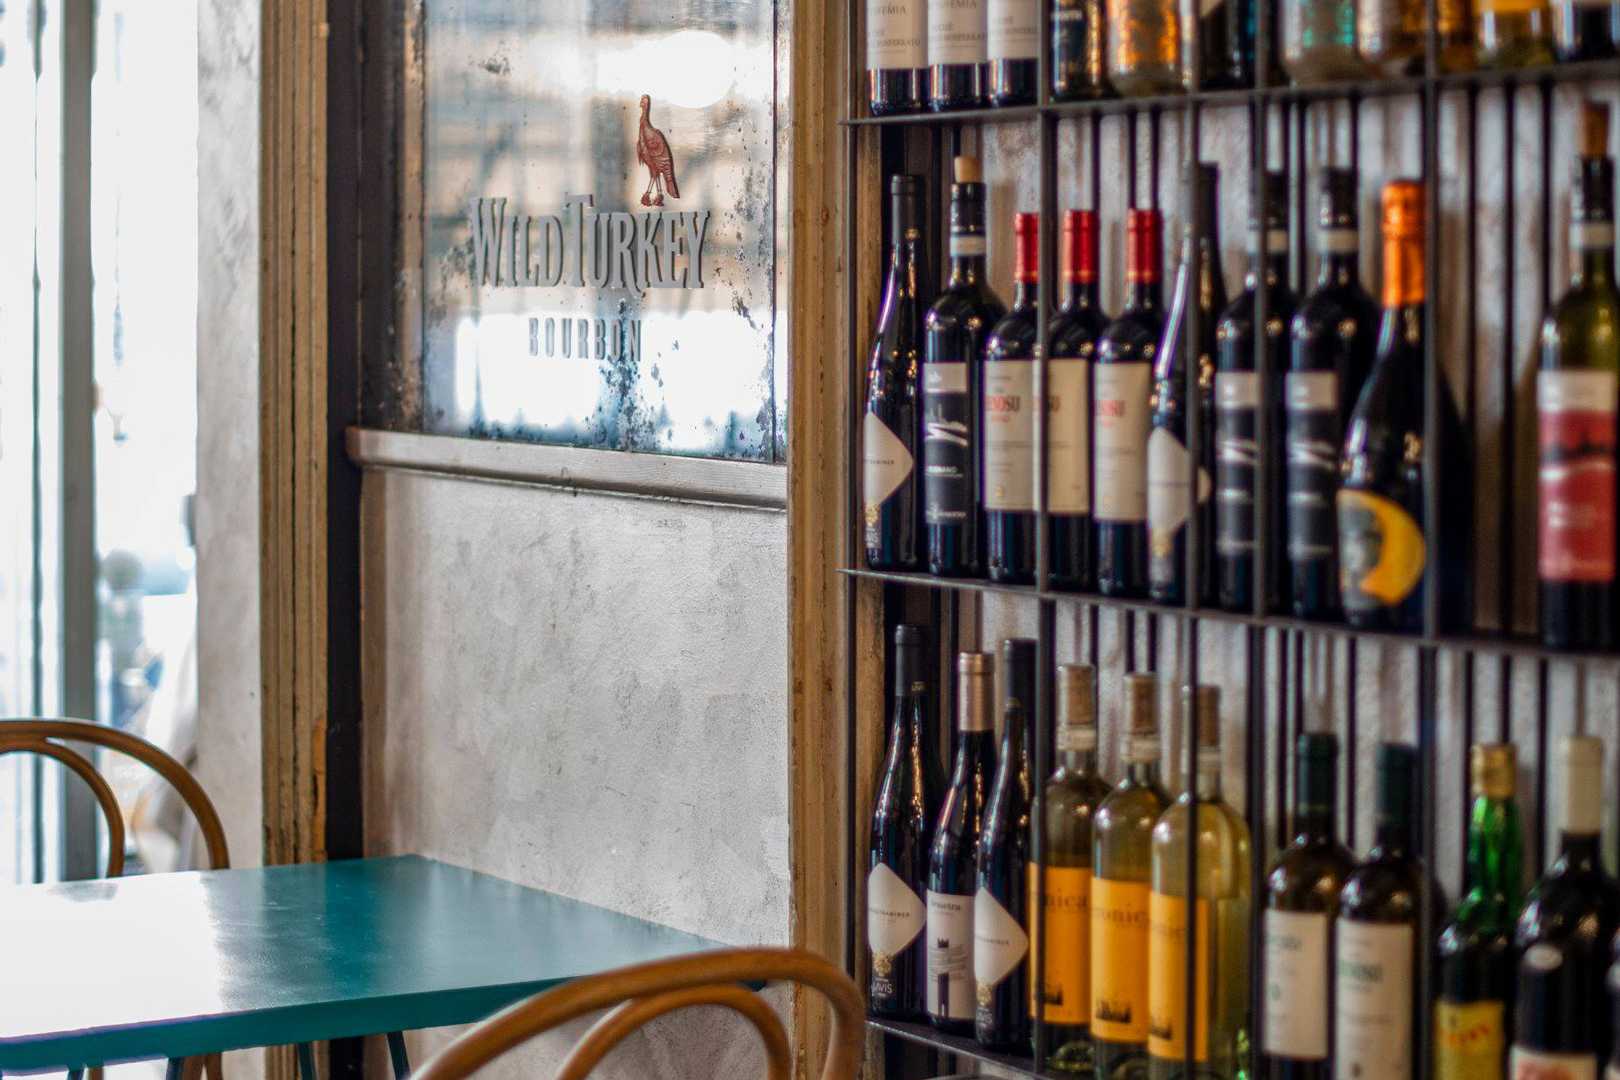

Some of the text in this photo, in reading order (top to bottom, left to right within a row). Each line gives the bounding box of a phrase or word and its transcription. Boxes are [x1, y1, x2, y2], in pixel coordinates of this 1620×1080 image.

[470, 193, 711, 299] WILD TURKEY
[528, 317, 643, 362] BOURBON
